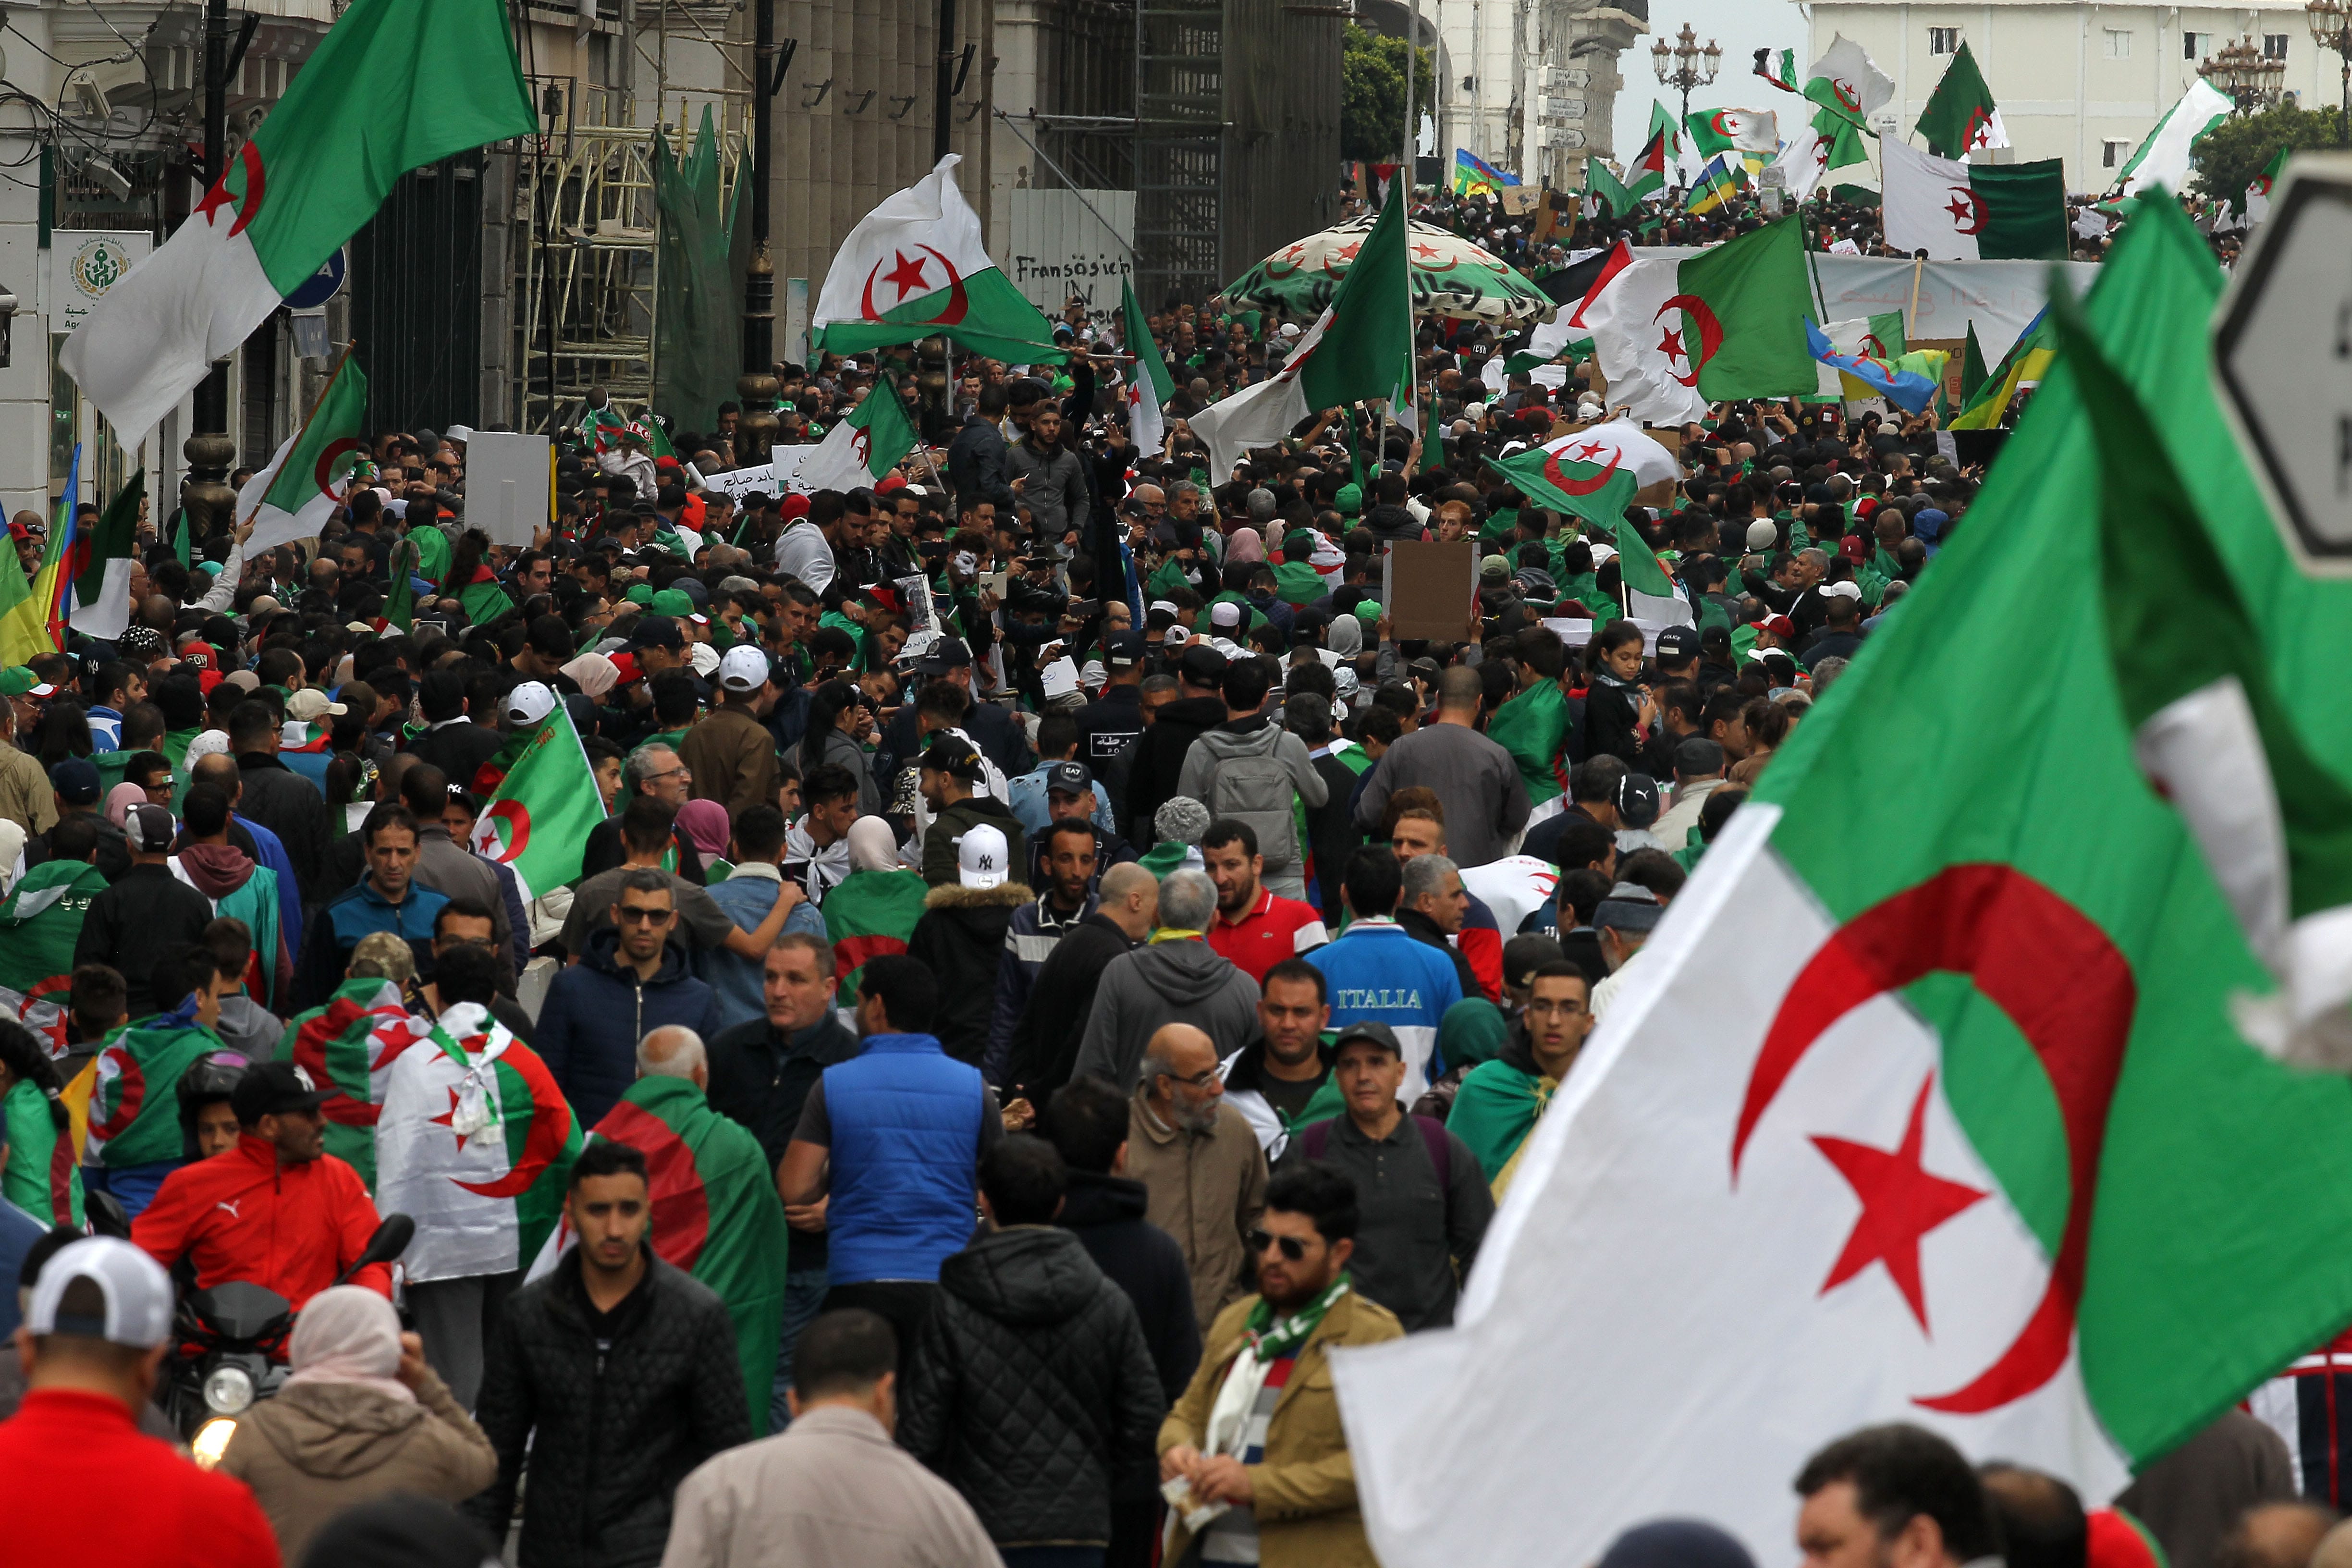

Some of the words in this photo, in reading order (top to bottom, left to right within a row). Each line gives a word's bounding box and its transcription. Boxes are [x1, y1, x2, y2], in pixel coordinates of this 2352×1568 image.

[1473, 344, 1487, 355] ICON
[723, 472, 753, 494] صالح
[1097, 736, 1130, 747] رطة
[979, 854, 992, 870] NY
[1337, 988, 1422, 1009] ITALIA
